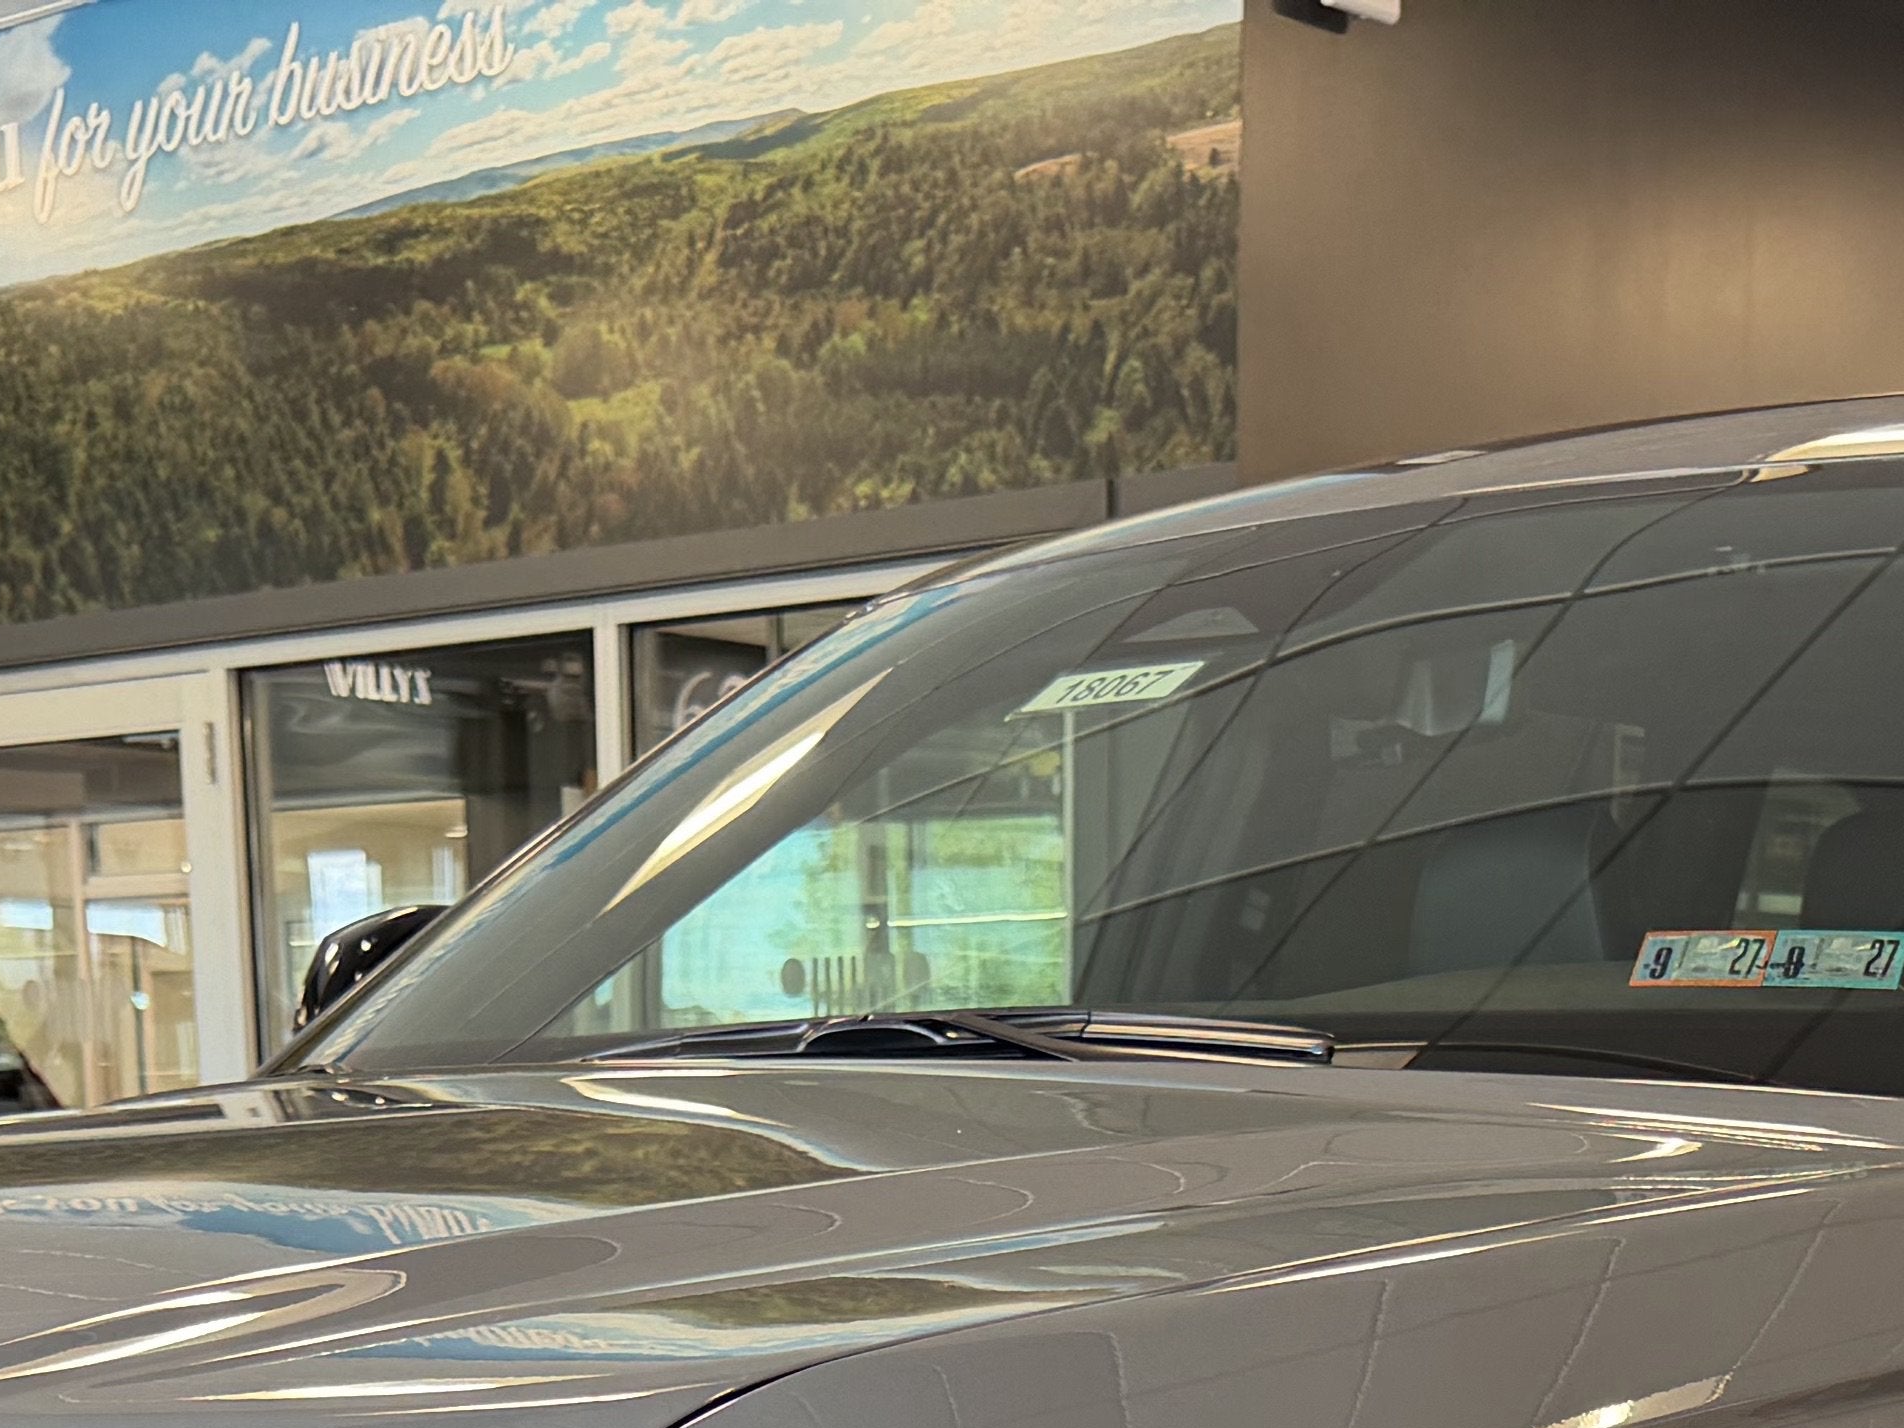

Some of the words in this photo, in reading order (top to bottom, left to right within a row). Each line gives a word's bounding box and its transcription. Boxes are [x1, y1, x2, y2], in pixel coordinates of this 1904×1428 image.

[33, 87, 117, 223] for
[120, 70, 262, 212] your
[267, 9, 515, 126] business
[324, 661, 432, 705] WILLYS
[1056, 669, 1175, 704] 18067
[1649, 946, 1673, 979] 9
[1728, 937, 1765, 977] 27
[1863, 938, 1900, 978] 27
